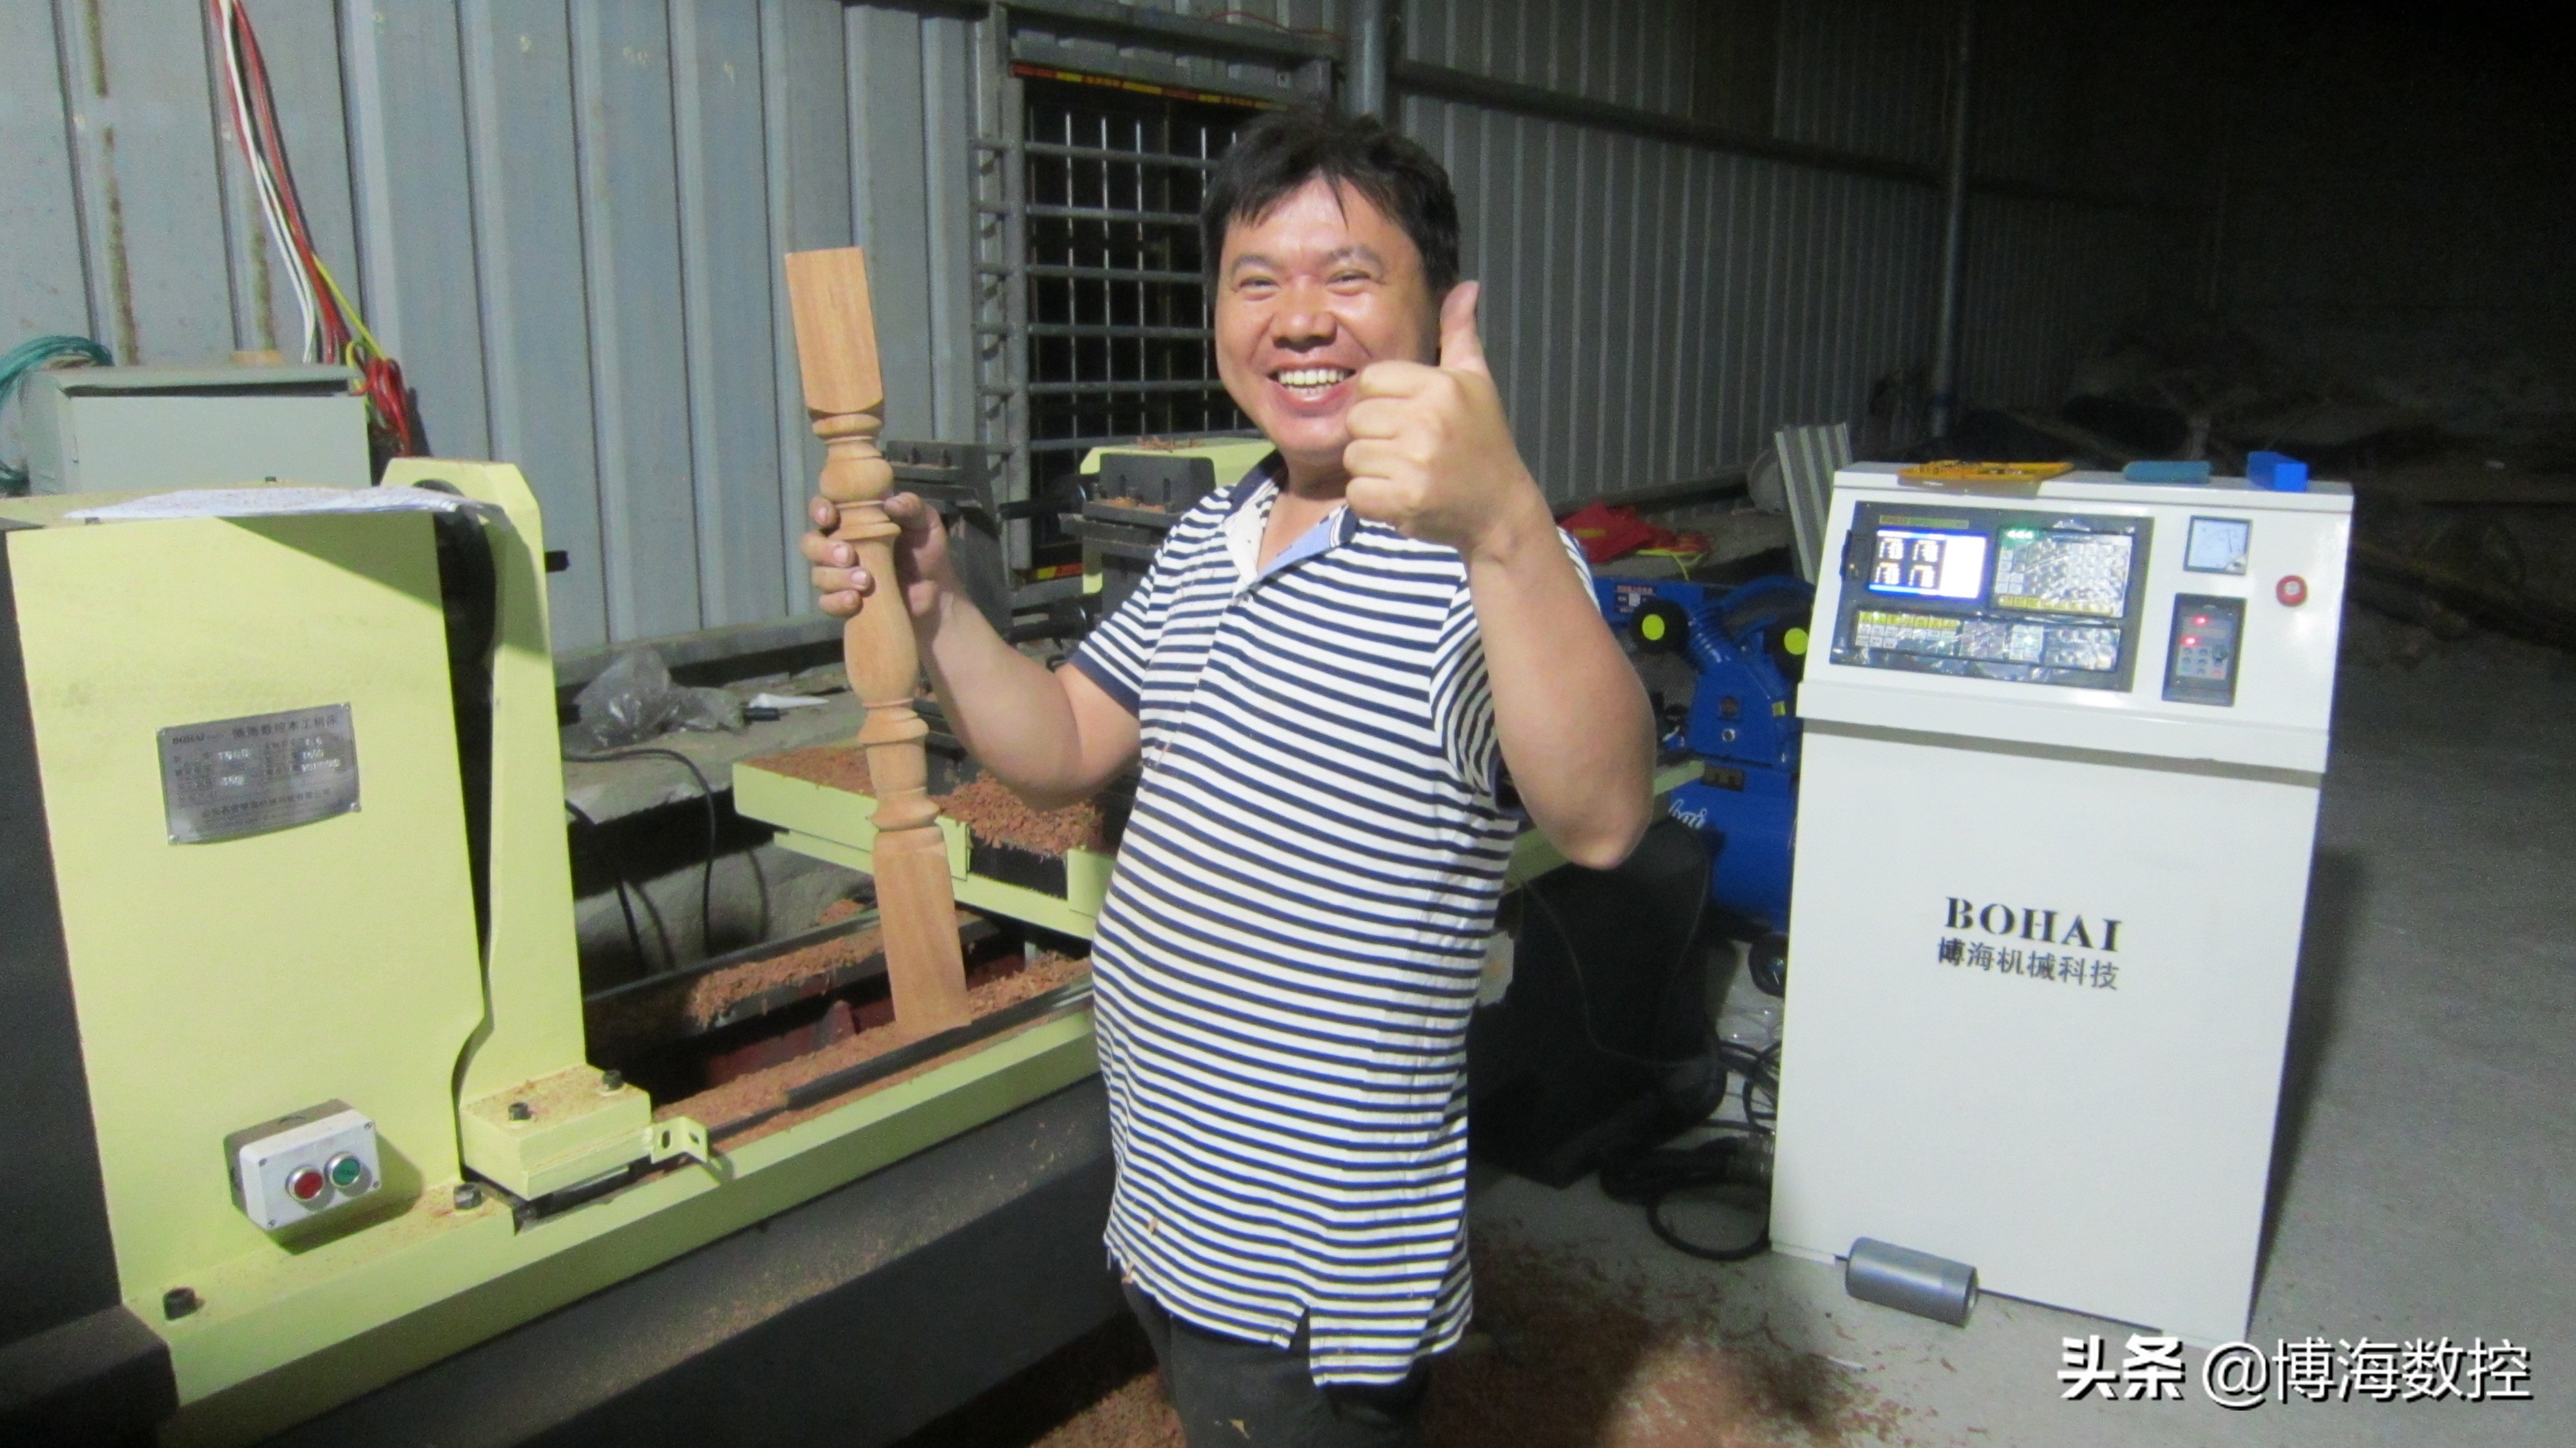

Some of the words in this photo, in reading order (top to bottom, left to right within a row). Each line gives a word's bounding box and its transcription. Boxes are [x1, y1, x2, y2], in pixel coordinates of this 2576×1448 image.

[1945, 897, 2122, 952] BOHAI
[1937, 937, 2119, 991] 博海机械科技
